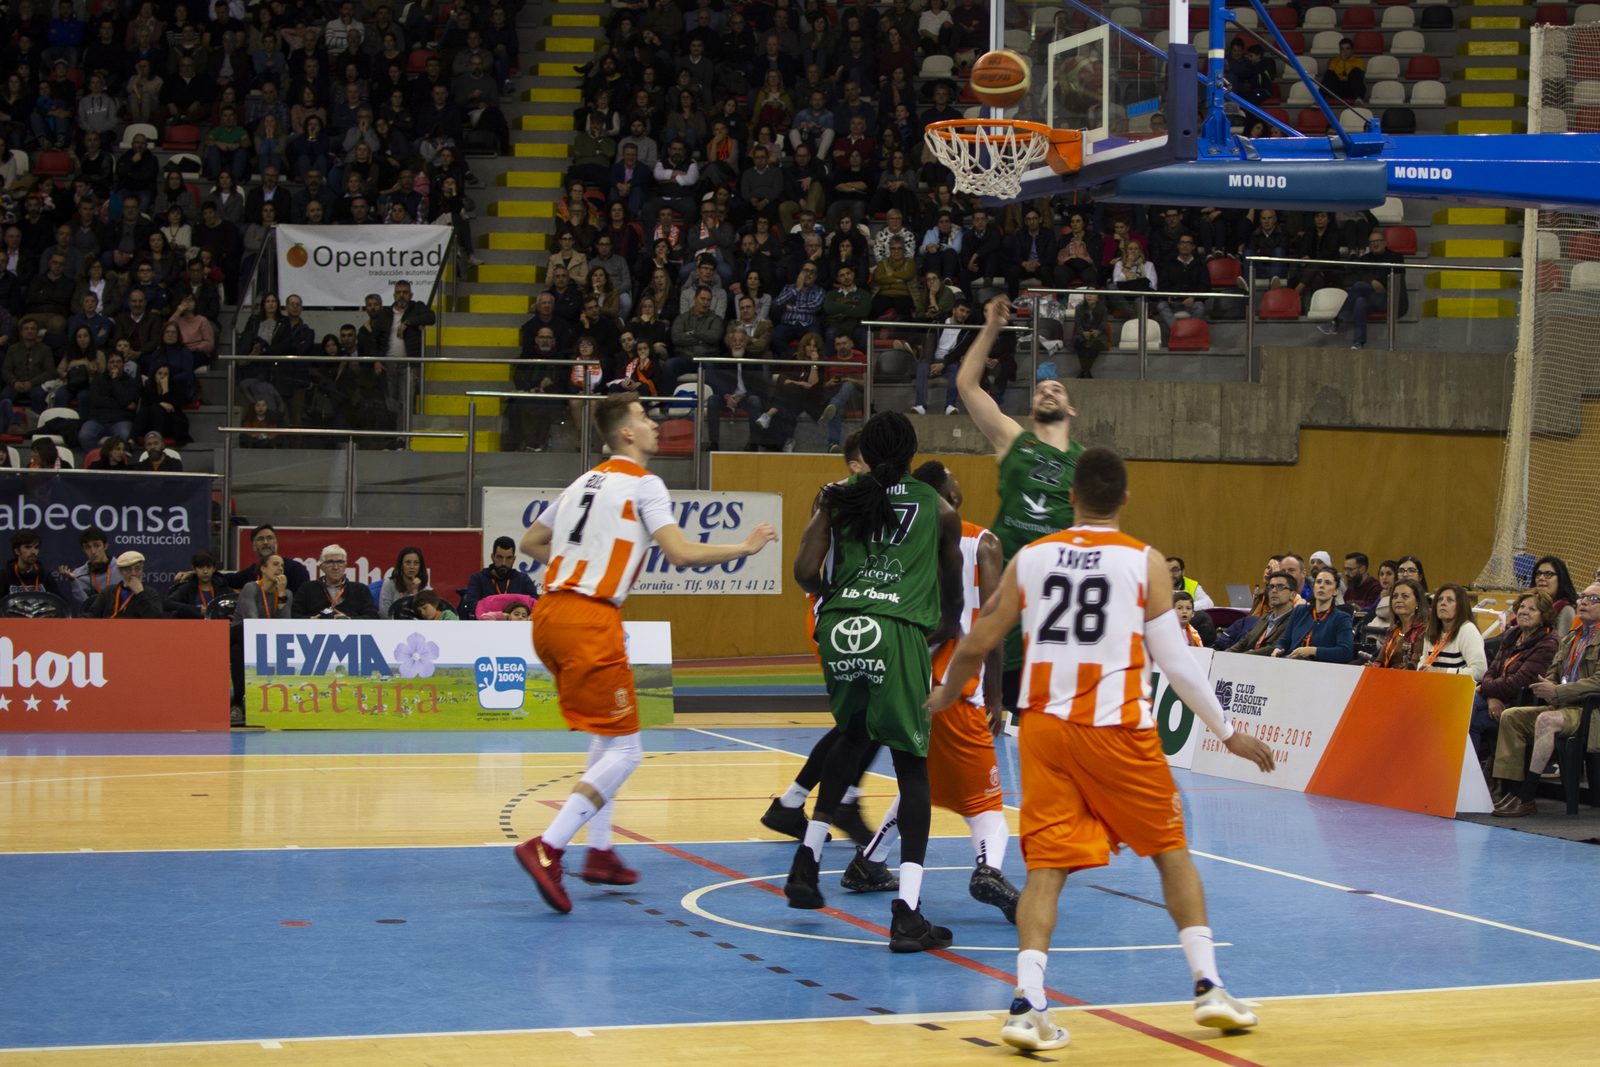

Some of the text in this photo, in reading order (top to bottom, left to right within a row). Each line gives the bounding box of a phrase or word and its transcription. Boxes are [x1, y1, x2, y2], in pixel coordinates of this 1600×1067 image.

[1394, 166, 1452, 180] MONDO
[1228, 174, 1287, 188] MONDO
[313, 244, 441, 272] Opentrad
[567, 492, 596, 546] 7
[115, 534, 190, 545] construcción
[1056, 547, 1102, 570] XAVIER
[684, 579, 702, 593] Tlf.
[706, 579, 726, 591] 981
[730, 580, 742, 591] 71
[745, 580, 758, 591] 41
[763, 579, 776, 591] 12
[842, 587, 900, 603] Librbank
[1036, 572, 1111, 646] 28
[256, 634, 393, 676] LEYMA
[828, 658, 886, 673] TOYOTA
[498, 672, 525, 682] 100%
[1236, 683, 1256, 694] CLUB
[258, 679, 442, 714] natura
[1233, 693, 1268, 707] BASQUET
[1254, 724, 1313, 748] 1996-2016
